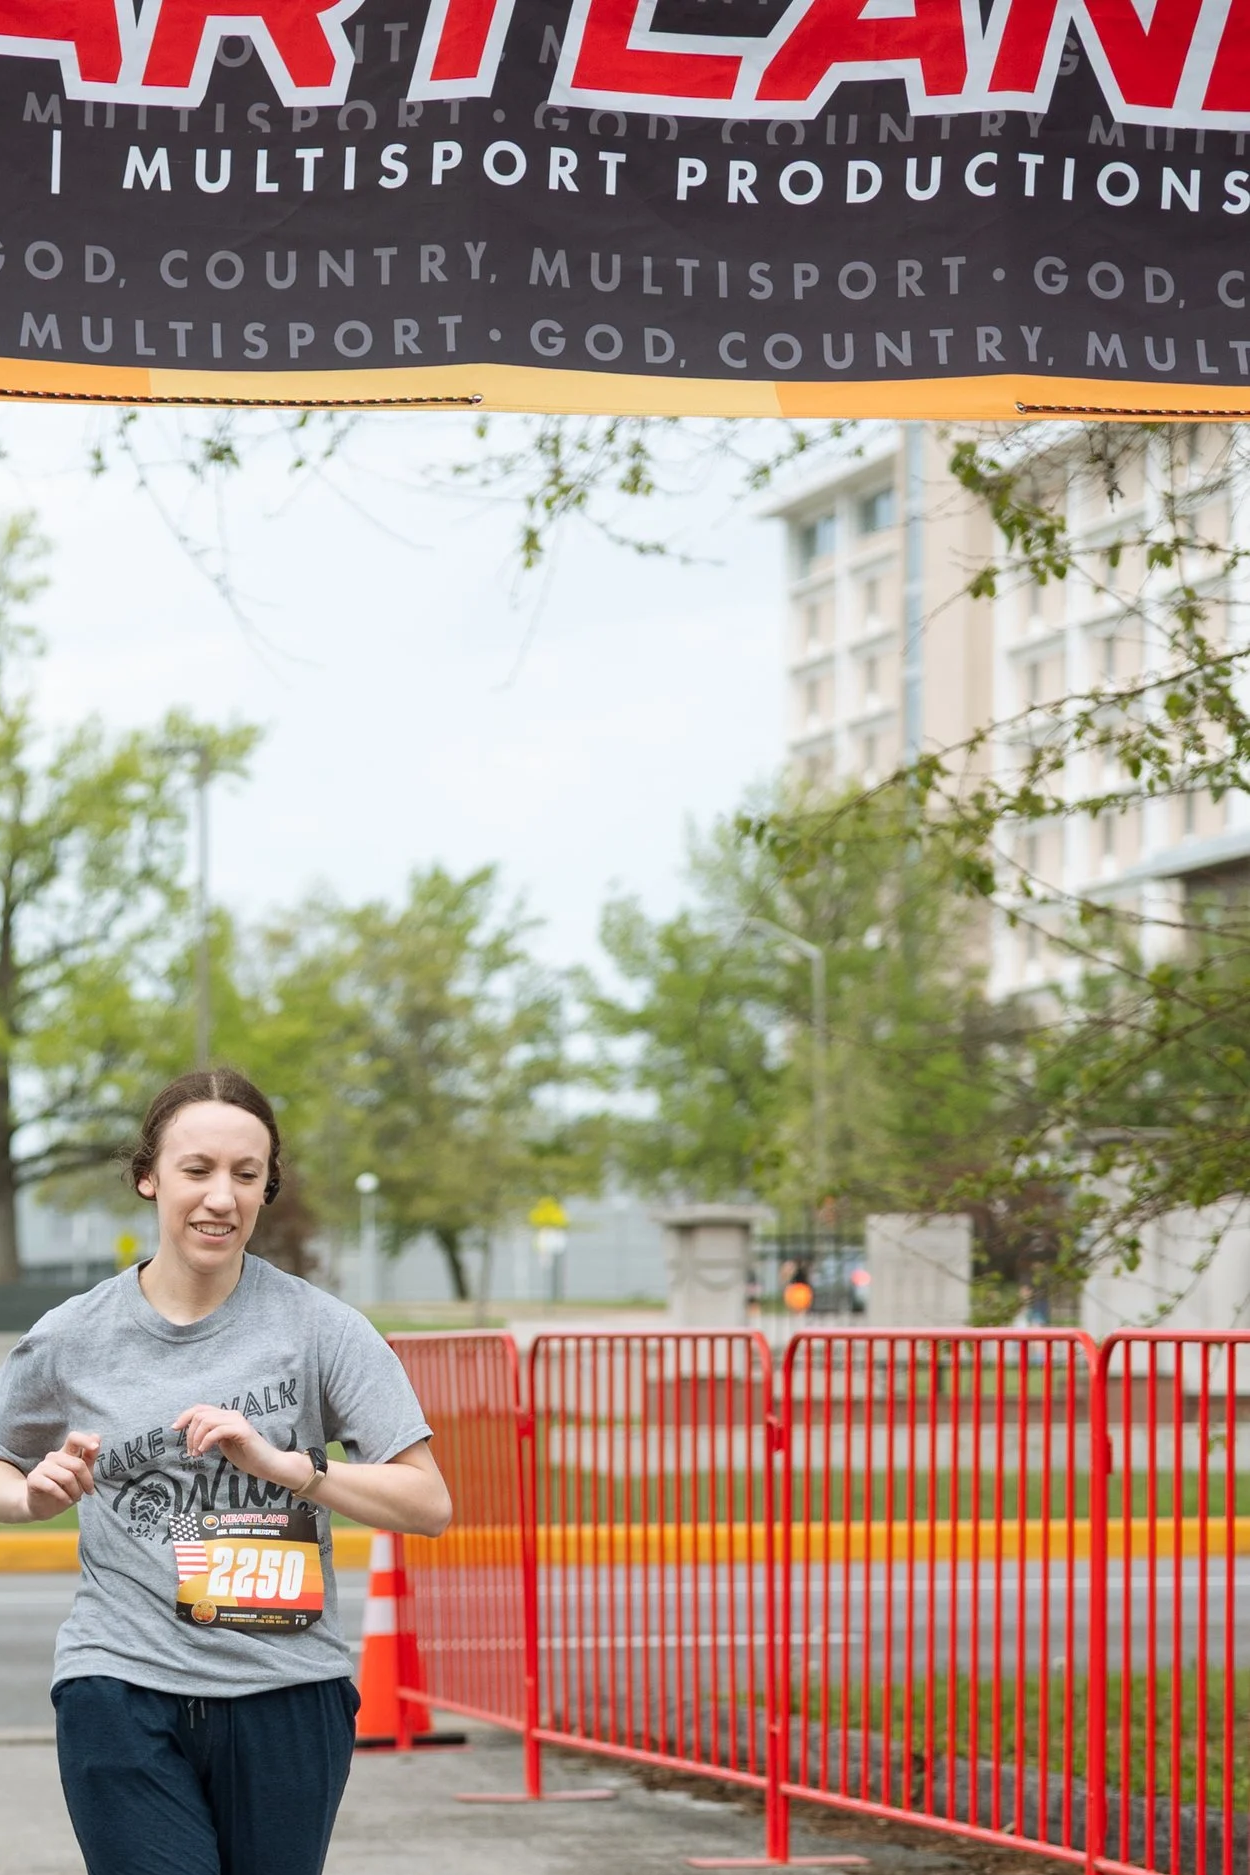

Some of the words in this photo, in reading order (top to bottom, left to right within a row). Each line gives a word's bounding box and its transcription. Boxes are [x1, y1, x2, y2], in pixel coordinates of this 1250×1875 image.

[122, 140, 627, 195] MULTISPORT
[676, 152, 1250, 214] PRODUCTIONS
[160, 242, 497, 290] COUNTRY,
[529, 248, 967, 300] MULTISPORT
[1034, 256, 1186, 308] GOD,
[19, 312, 463, 360] MULTISPORT
[529, 319, 687, 368] GOD,
[718, 325, 1054, 370] COUNTRY,
[1086, 331, 1250, 376] MULT
[96, 1427, 166, 1480] TAKE
[220, 1513, 289, 1524] HEARTLAND
[207, 1547, 306, 1600] 2250
